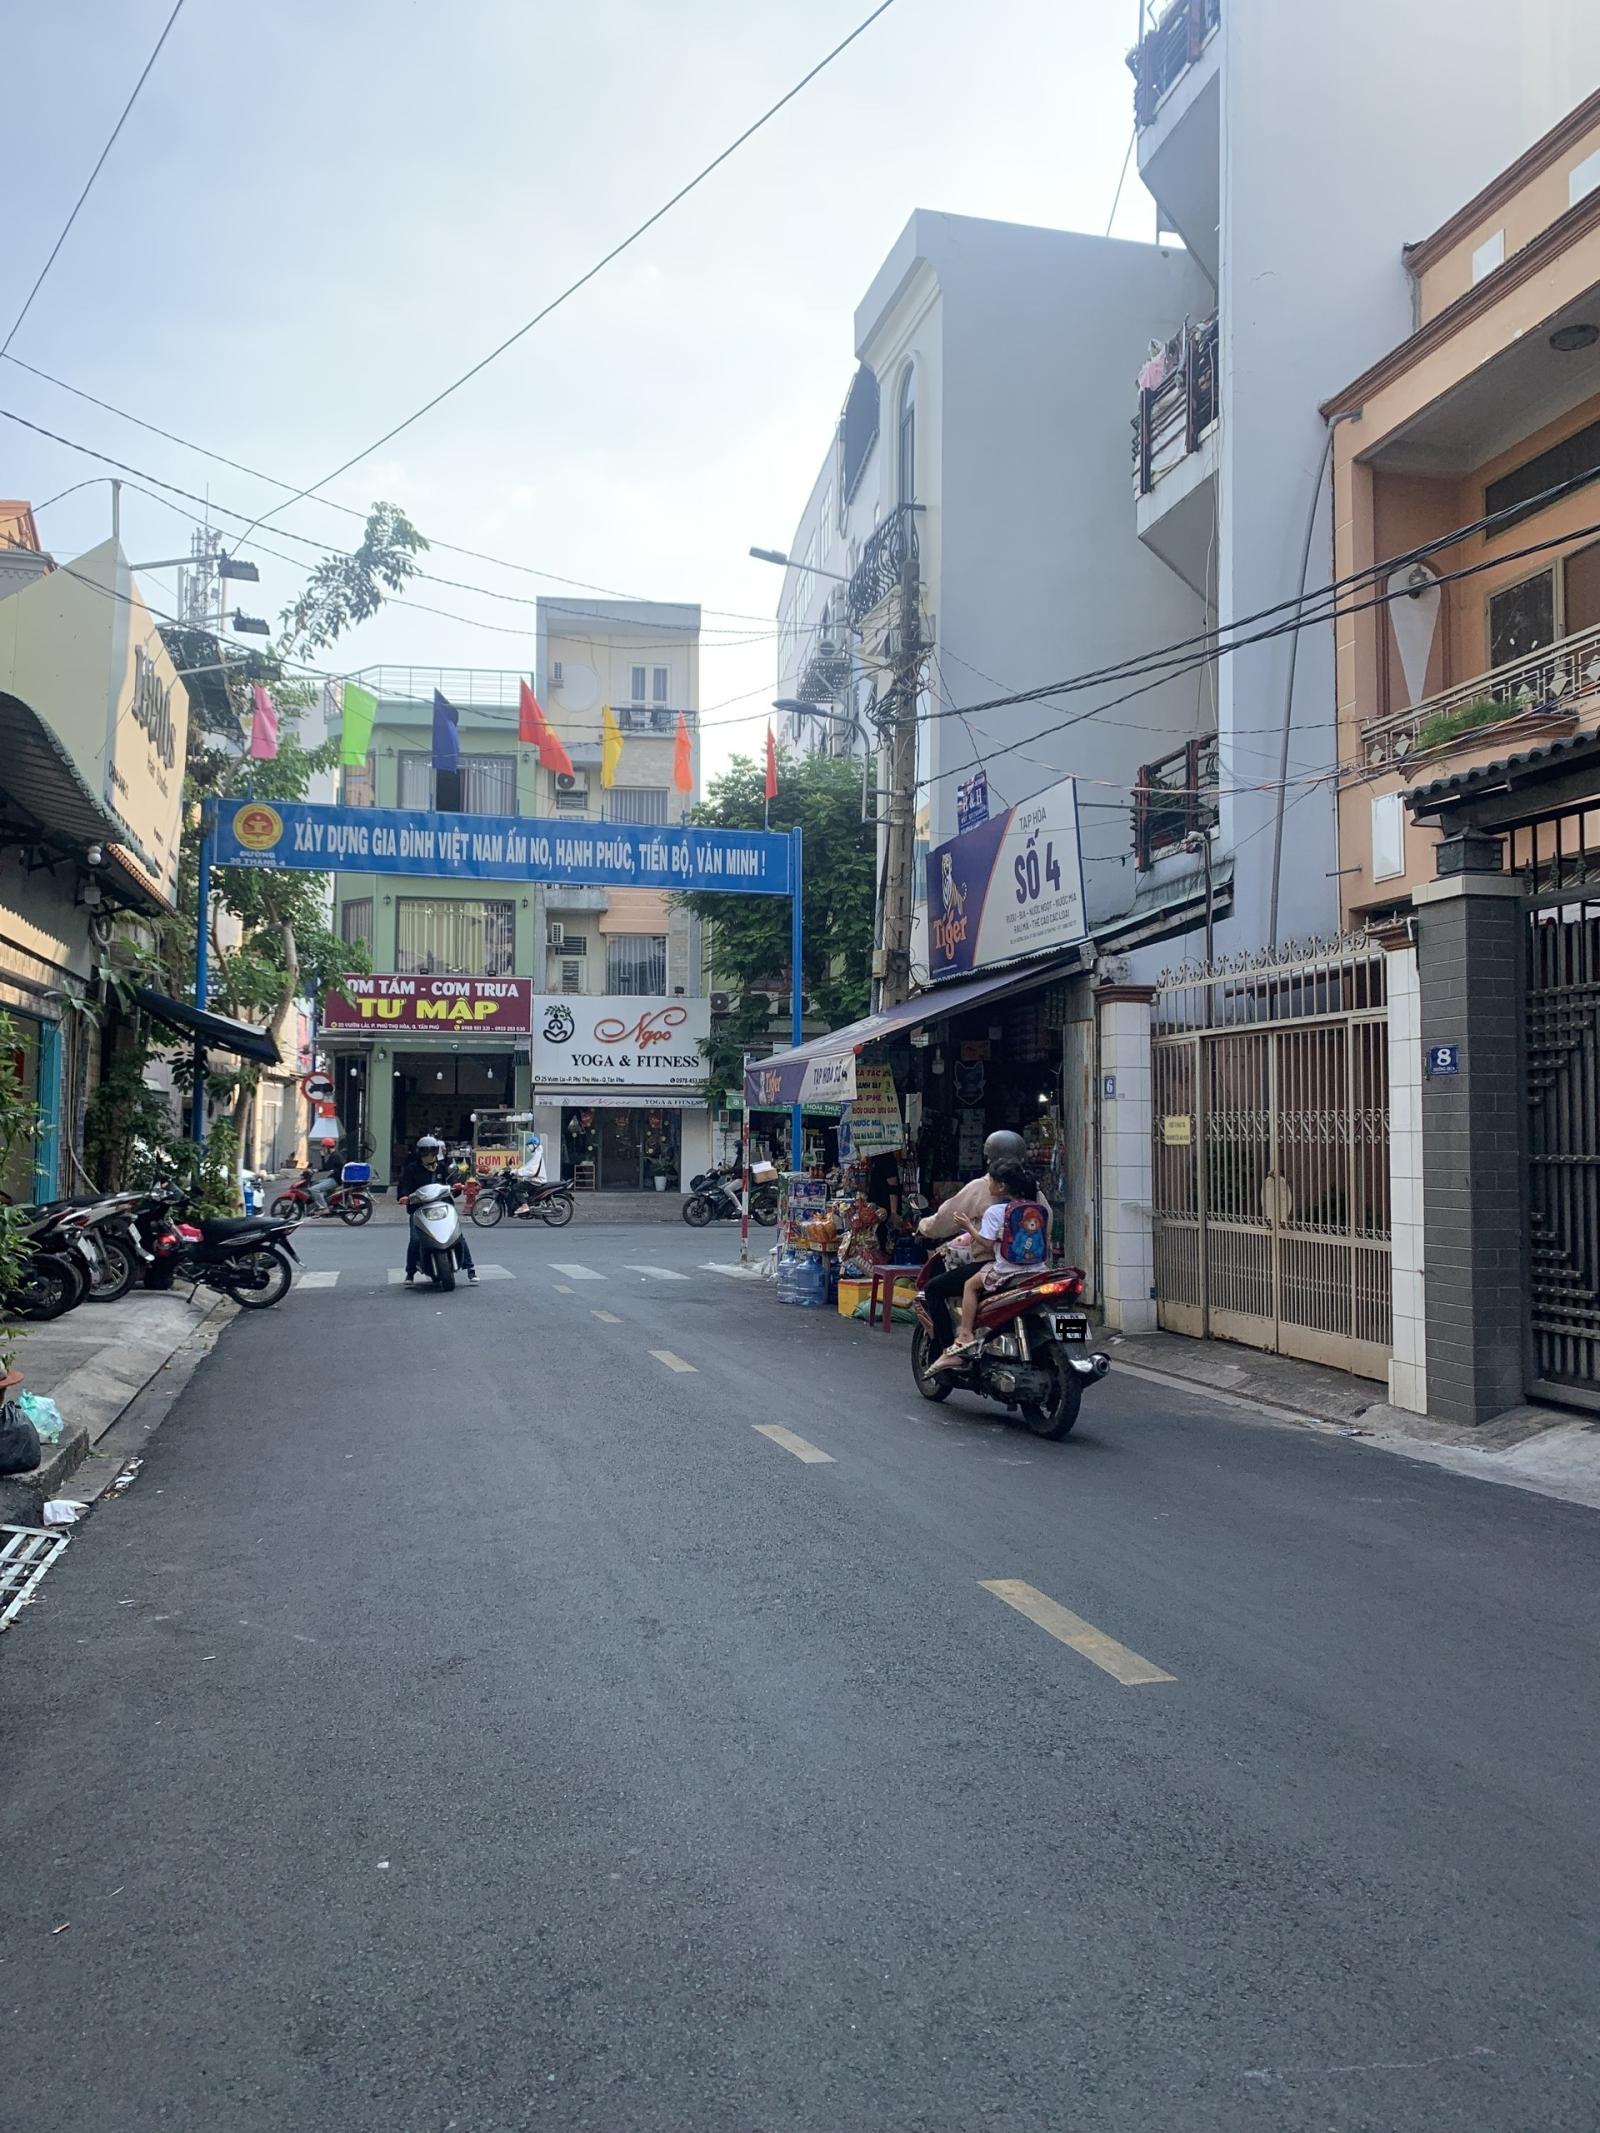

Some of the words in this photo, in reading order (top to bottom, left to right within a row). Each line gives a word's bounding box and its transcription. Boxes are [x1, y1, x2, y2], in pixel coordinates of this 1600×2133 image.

[1018, 816, 1033, 834] TẠP
[1033, 806, 1047, 826] HÓA
[294, 817, 324, 851] XÂY
[327, 825, 368, 861] DỰNG
[372, 827, 397, 857] GIA
[400, 823, 434, 859] ĐÌNH
[438, 826, 470, 867] VIỆT
[473, 834, 503, 863] NAM
[506, 827, 527, 864] ẤM
[530, 838, 552, 871] NO,
[556, 839, 592, 873] HẠNH
[596, 836, 635, 875] PHÚC,
[638, 835, 668, 872] TIẾN
[671, 839, 693, 879] BỘ,
[696, 841, 722, 875] VĂN
[726, 848, 758, 876] MINH
[761, 850, 766, 877] !
[1014, 828, 1041, 905] SỐ
[1045, 841, 1061, 892] 4
[933, 911, 968, 960] Tiger
[336, 978, 374, 994] ƠM
[378, 976, 415, 995] TẤM
[431, 981, 470, 996] CƠM
[474, 982, 519, 998] TRƯA
[356, 997, 407, 1019] TƯ
[416, 996, 500, 1025] MẬP
[571, 1054, 614, 1067] YOGA
[619, 1055, 631, 1068] &
[637, 1055, 699, 1068] FITNESS
[1437, 1048, 1451, 1066] 8
[841, 1064, 848, 1081] 4
[766, 1068, 782, 1104] Tiger
[1107, 1079, 1113, 1094] 6
[478, 1155, 500, 1166] CƠM
